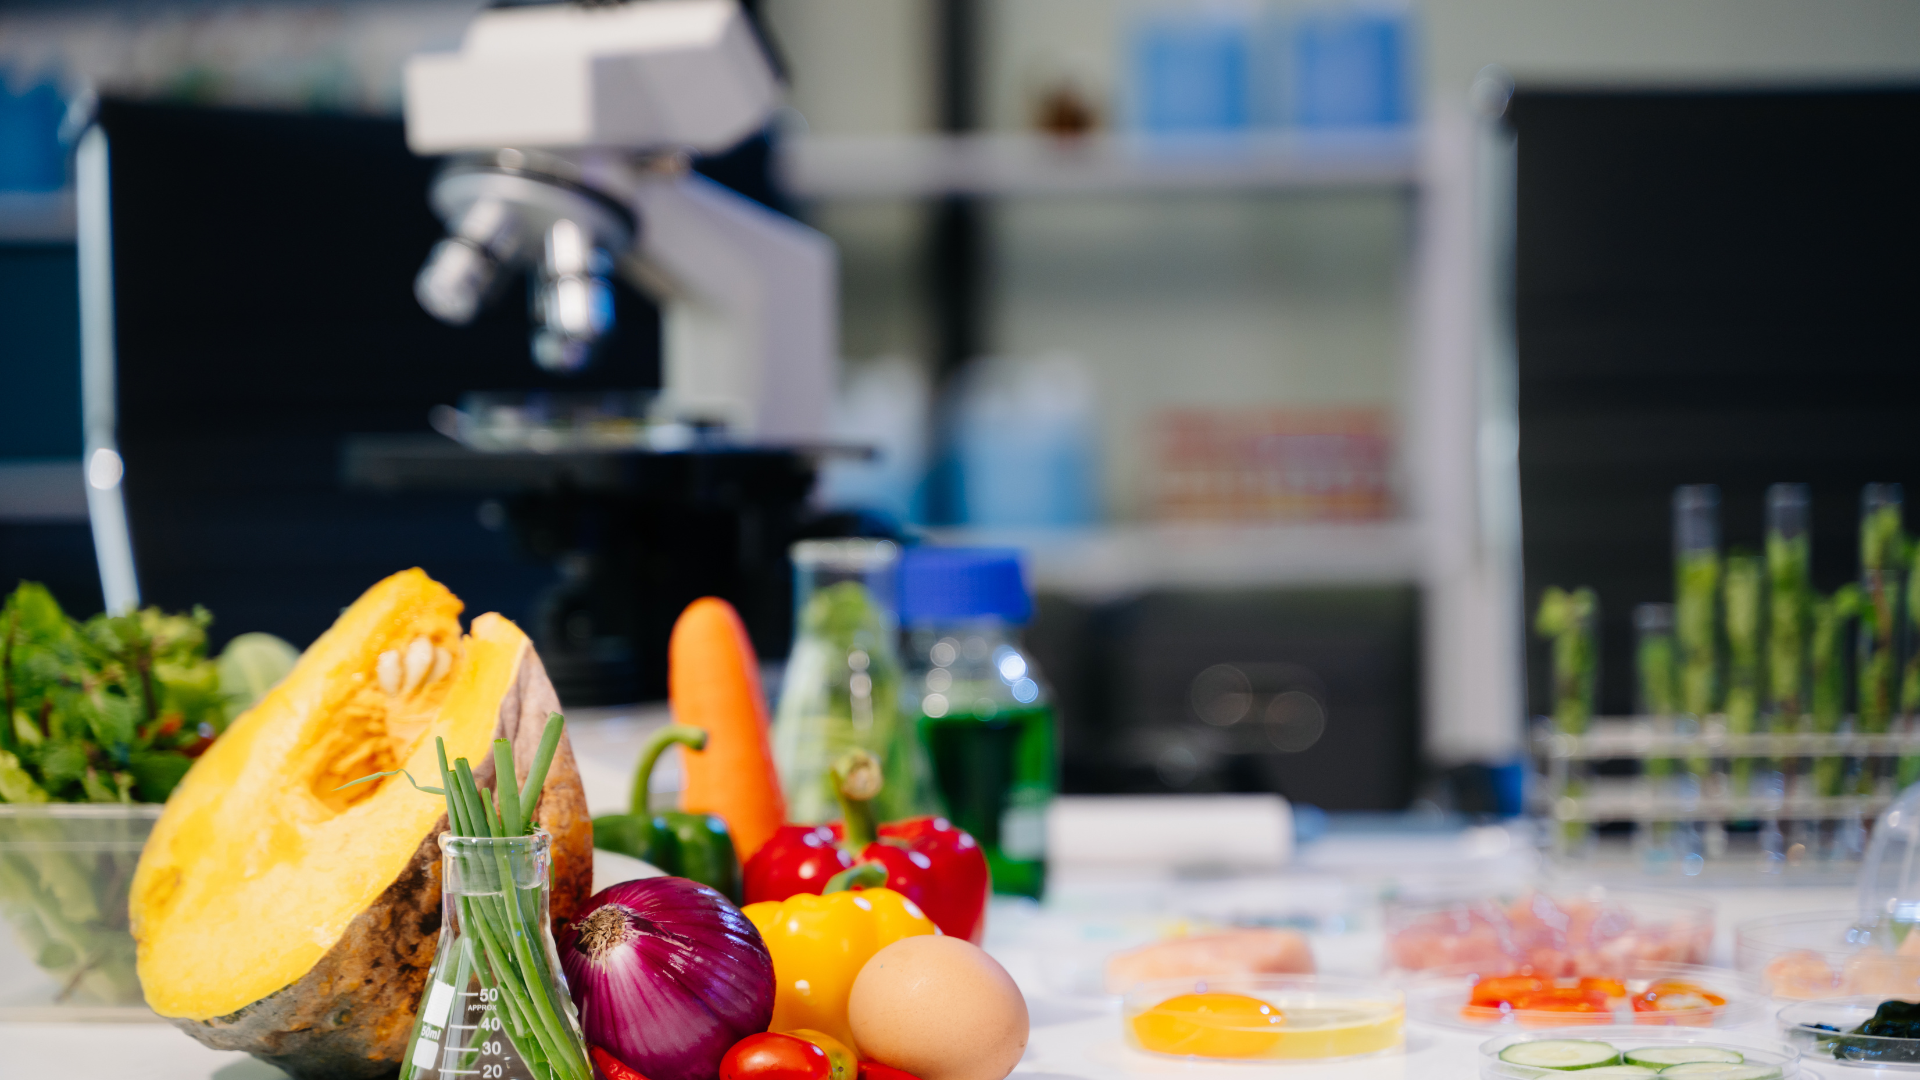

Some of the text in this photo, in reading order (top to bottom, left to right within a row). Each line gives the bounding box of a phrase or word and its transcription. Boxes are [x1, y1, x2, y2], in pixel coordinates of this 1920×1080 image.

[480, 988, 498, 1002] 50
[481, 1017, 500, 1031] 40
[421, 1025, 441, 1040] 50ml
[482, 1041, 501, 1055] 30
[483, 1064, 502, 1078] 20
